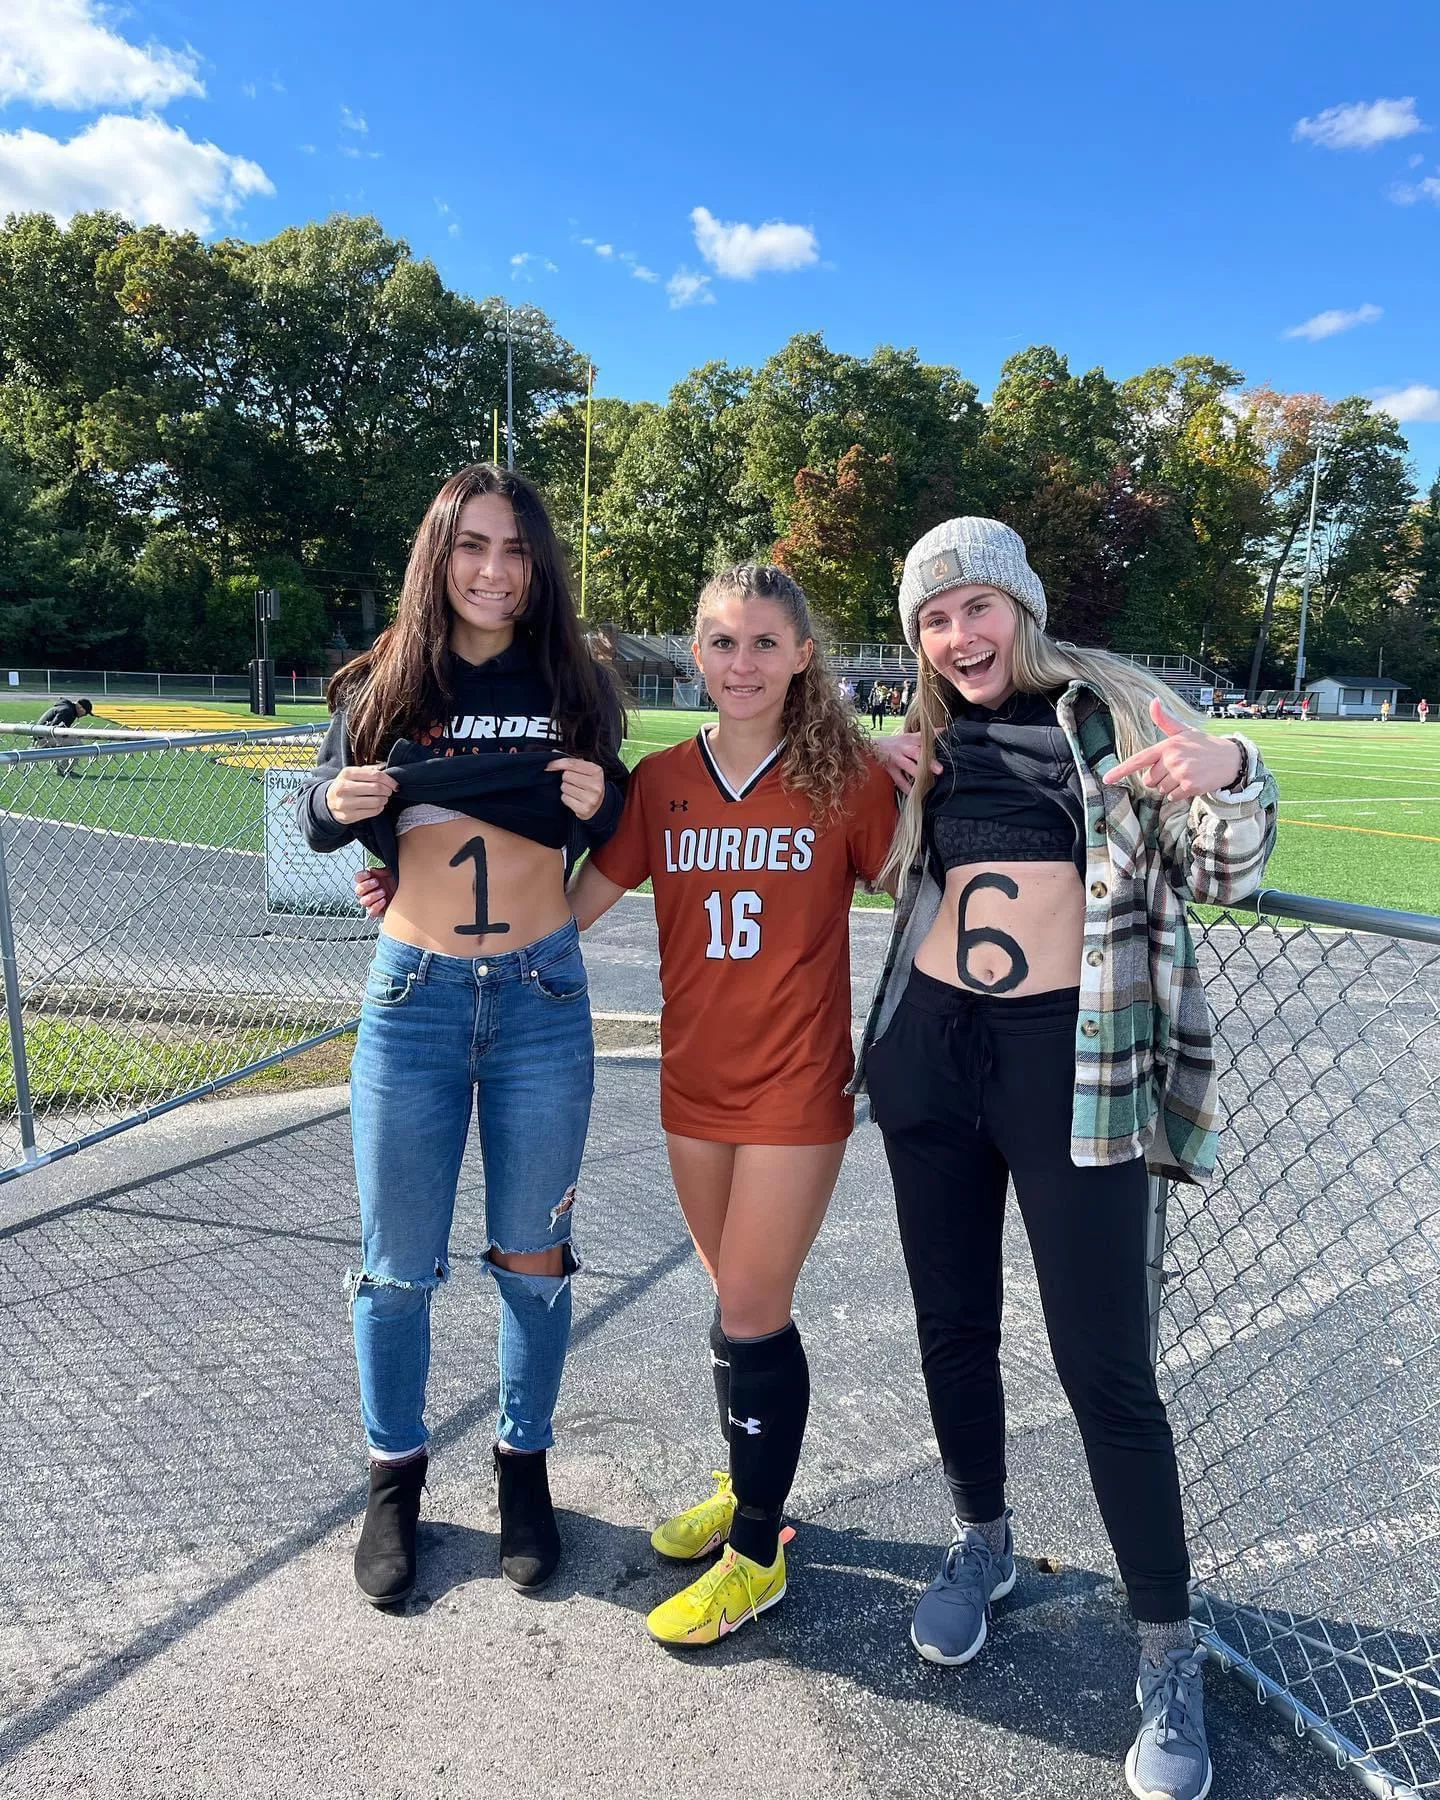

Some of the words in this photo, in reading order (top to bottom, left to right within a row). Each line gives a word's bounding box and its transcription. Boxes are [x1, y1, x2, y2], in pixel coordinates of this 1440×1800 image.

[449, 835, 511, 935] 1
[664, 827, 816, 873] LOURDES
[703, 889, 764, 960] 16
[957, 872, 1029, 994] 6
